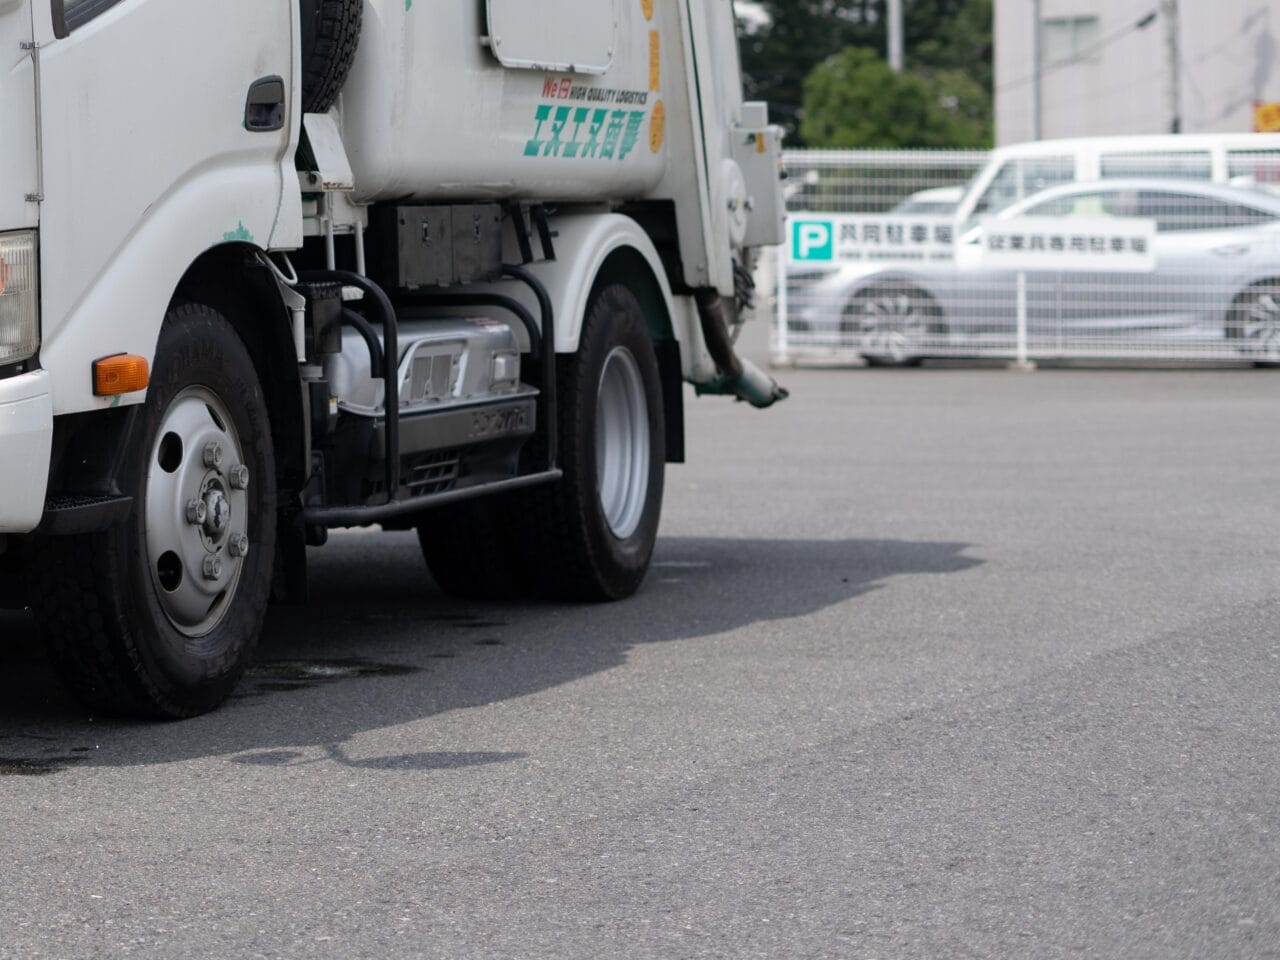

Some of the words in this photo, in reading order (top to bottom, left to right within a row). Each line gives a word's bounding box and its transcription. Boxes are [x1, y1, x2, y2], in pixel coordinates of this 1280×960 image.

[587, 87, 616, 103] QUALITY
[615, 89, 648, 105] LOGISTICS
[799, 223, 829, 259] P
